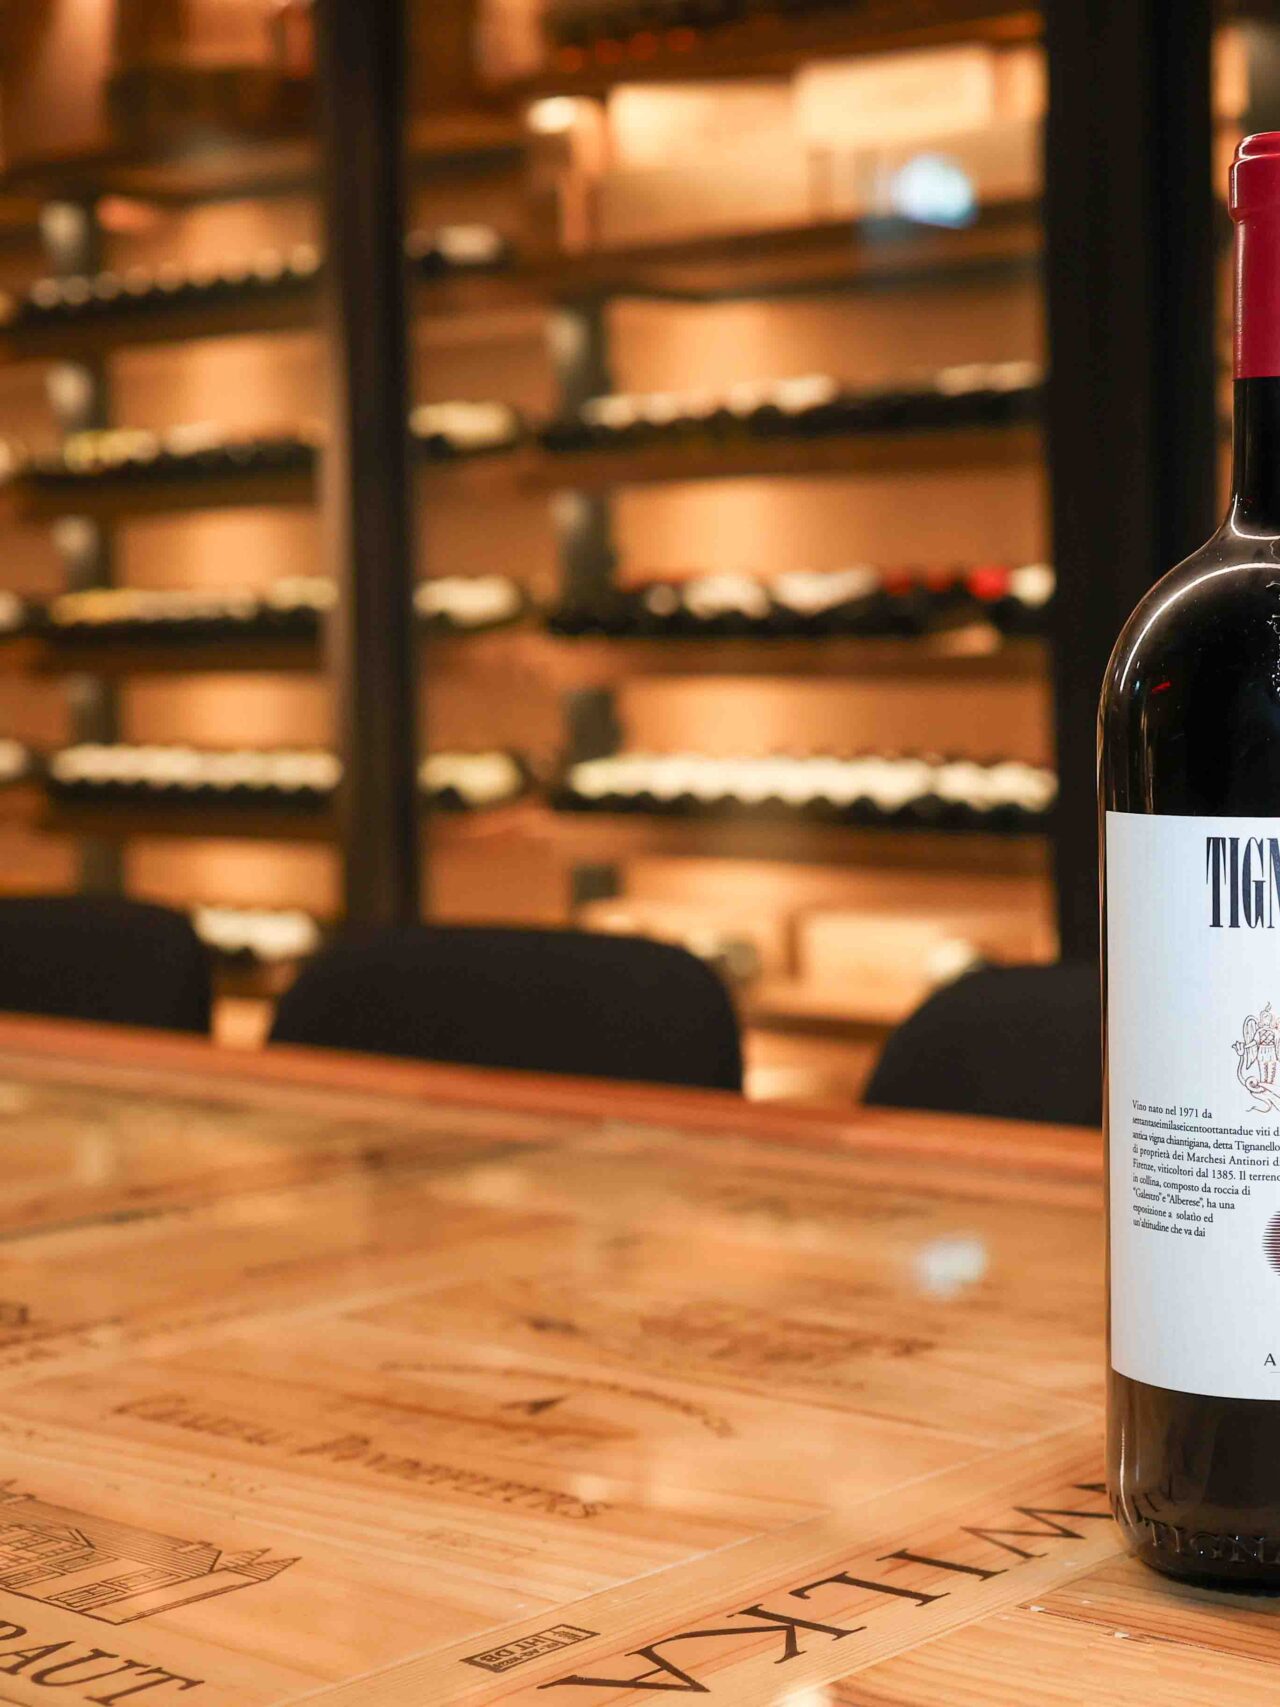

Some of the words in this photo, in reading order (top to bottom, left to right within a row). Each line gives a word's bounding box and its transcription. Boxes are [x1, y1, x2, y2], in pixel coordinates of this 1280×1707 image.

[1132, 1099, 1147, 1111] Vino
[1148, 1105, 1163, 1114] nato
[1165, 1106, 1176, 1115] nel
[1179, 1107, 1198, 1118] 1971
[1202, 1109, 1212, 1119] da
[1149, 1132, 1165, 1145] vigna
[1166, 1134, 1211, 1150] chiantigiana,
[1213, 1140, 1233, 1150] detta
[1256, 1129, 1270, 1137] viti
[1140, 1147, 1170, 1159] proprietà
[1172, 1150, 1184, 1161] dei
[1187, 1152, 1226, 1165] Marchesi
[1228, 1155, 1270, 1166] Antinori
[1132, 1158, 1156, 1173] Firenze,
[1158, 1163, 1194, 1177] viticoltori
[1196, 1167, 1209, 1178] dal
[1212, 1170, 1236, 1181] 1385.
[1239, 1170, 1246, 1181] Il
[1140, 1175, 1162, 1188] collina,
[1163, 1181, 1199, 1193] composto
[1201, 1183, 1212, 1193] da
[1214, 1185, 1239, 1196] roccia
[1242, 1185, 1251, 1196] di
[1133, 1204, 1167, 1217] esposizione
[1204, 1213, 1214, 1223] ed
[1207, 1198, 1217, 1208] ha
[1219, 1202, 1235, 1210] una
[1171, 1224, 1183, 1234] che
[1184, 1228, 1192, 1236] va
[1194, 1227, 1206, 1237] dai
